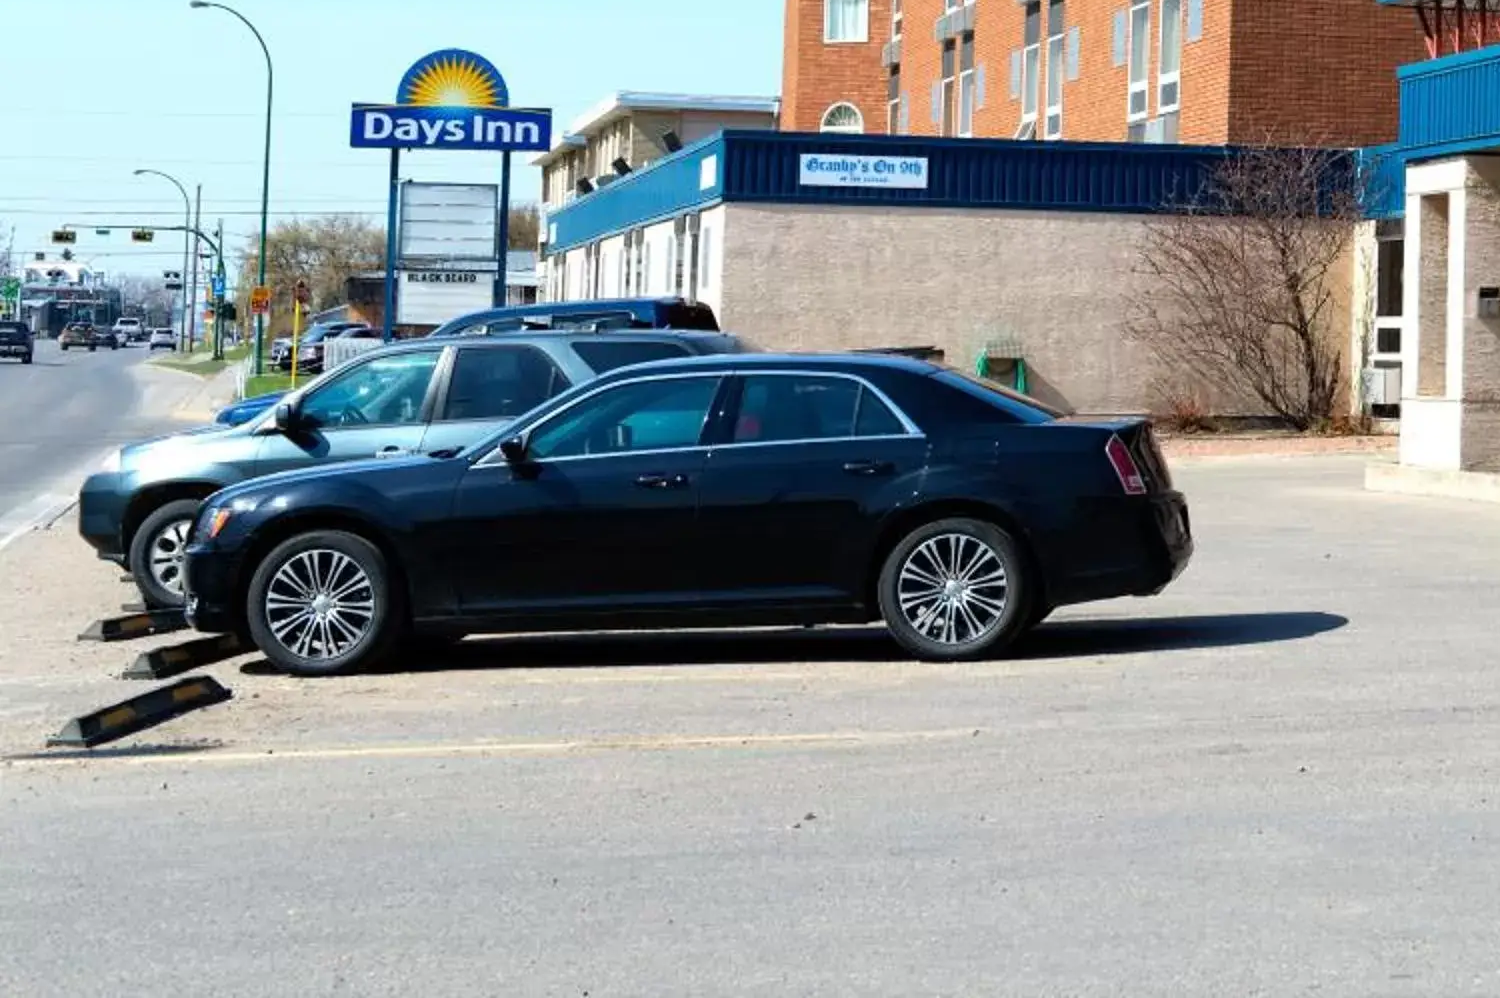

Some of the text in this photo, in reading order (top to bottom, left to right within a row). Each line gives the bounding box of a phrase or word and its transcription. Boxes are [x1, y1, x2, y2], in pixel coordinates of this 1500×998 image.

[363, 111, 540, 145] Days Inn
[873, 159, 895, 175] On
[899, 160, 922, 177] 9th
